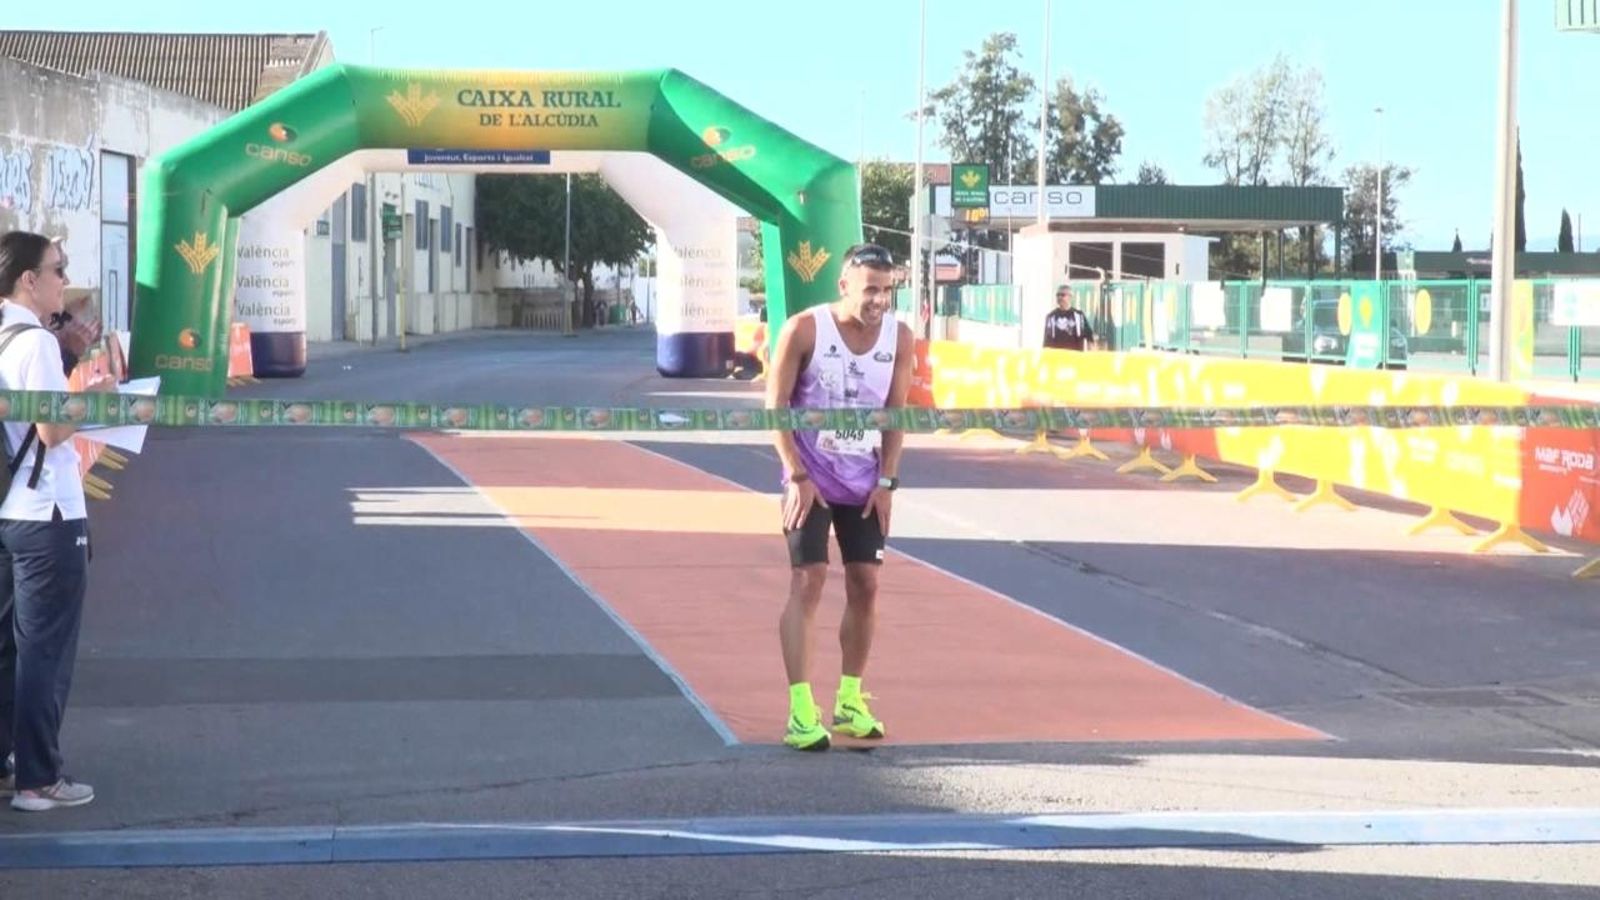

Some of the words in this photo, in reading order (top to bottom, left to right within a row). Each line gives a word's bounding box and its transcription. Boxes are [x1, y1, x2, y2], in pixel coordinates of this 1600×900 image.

[457, 89, 535, 107] CAIXA
[542, 90, 622, 108] RURAL
[479, 113, 503, 127] DE
[245, 142, 313, 167] canso
[994, 191, 1083, 205] canso
[835, 428, 865, 441] 5049
